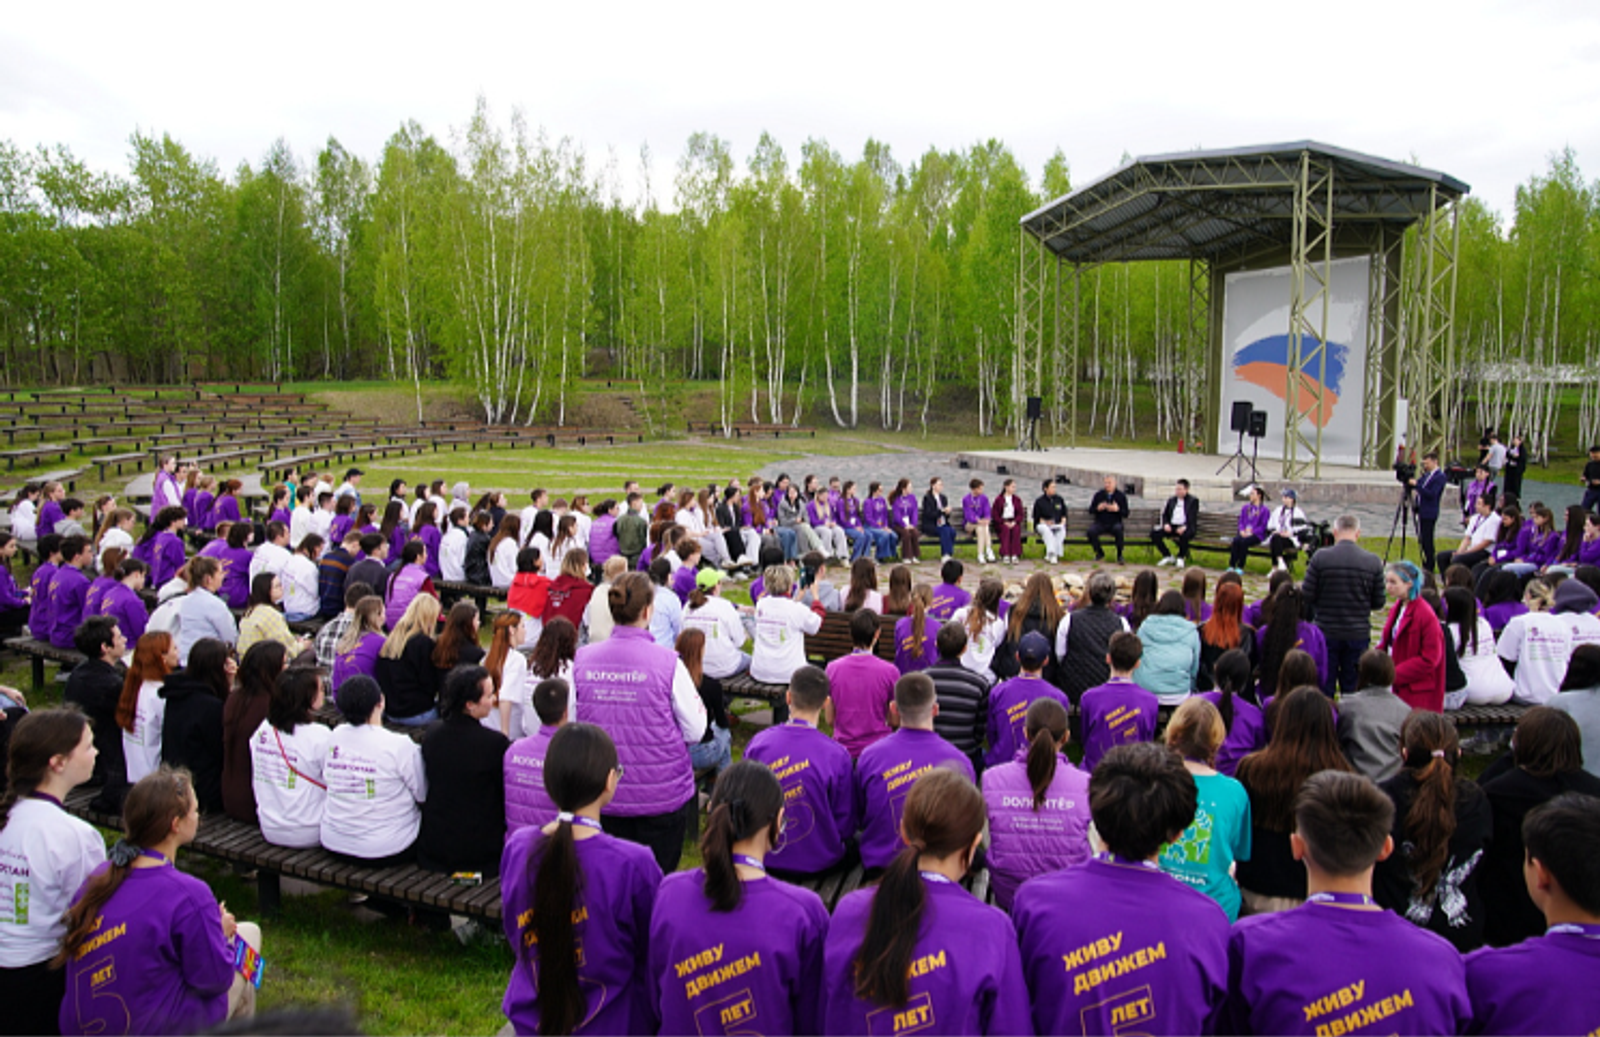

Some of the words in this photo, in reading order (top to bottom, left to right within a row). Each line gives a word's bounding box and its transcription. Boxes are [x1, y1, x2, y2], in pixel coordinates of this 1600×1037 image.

[674, 942, 723, 979] ЖИВУ
[1062, 930, 1123, 972] ЖИВУ
[1073, 940, 1166, 997] ДВИЖЕМ
[685, 951, 762, 1001] ДВИЖЕМ
[720, 999, 751, 1026] ЛЕТ
[893, 1004, 930, 1032] ЛЕТ
[1111, 997, 1149, 1026] ЛЕТ
[1302, 979, 1365, 1022] ЖИВУ
[1316, 988, 1415, 1037] ДВИЖЕМ
